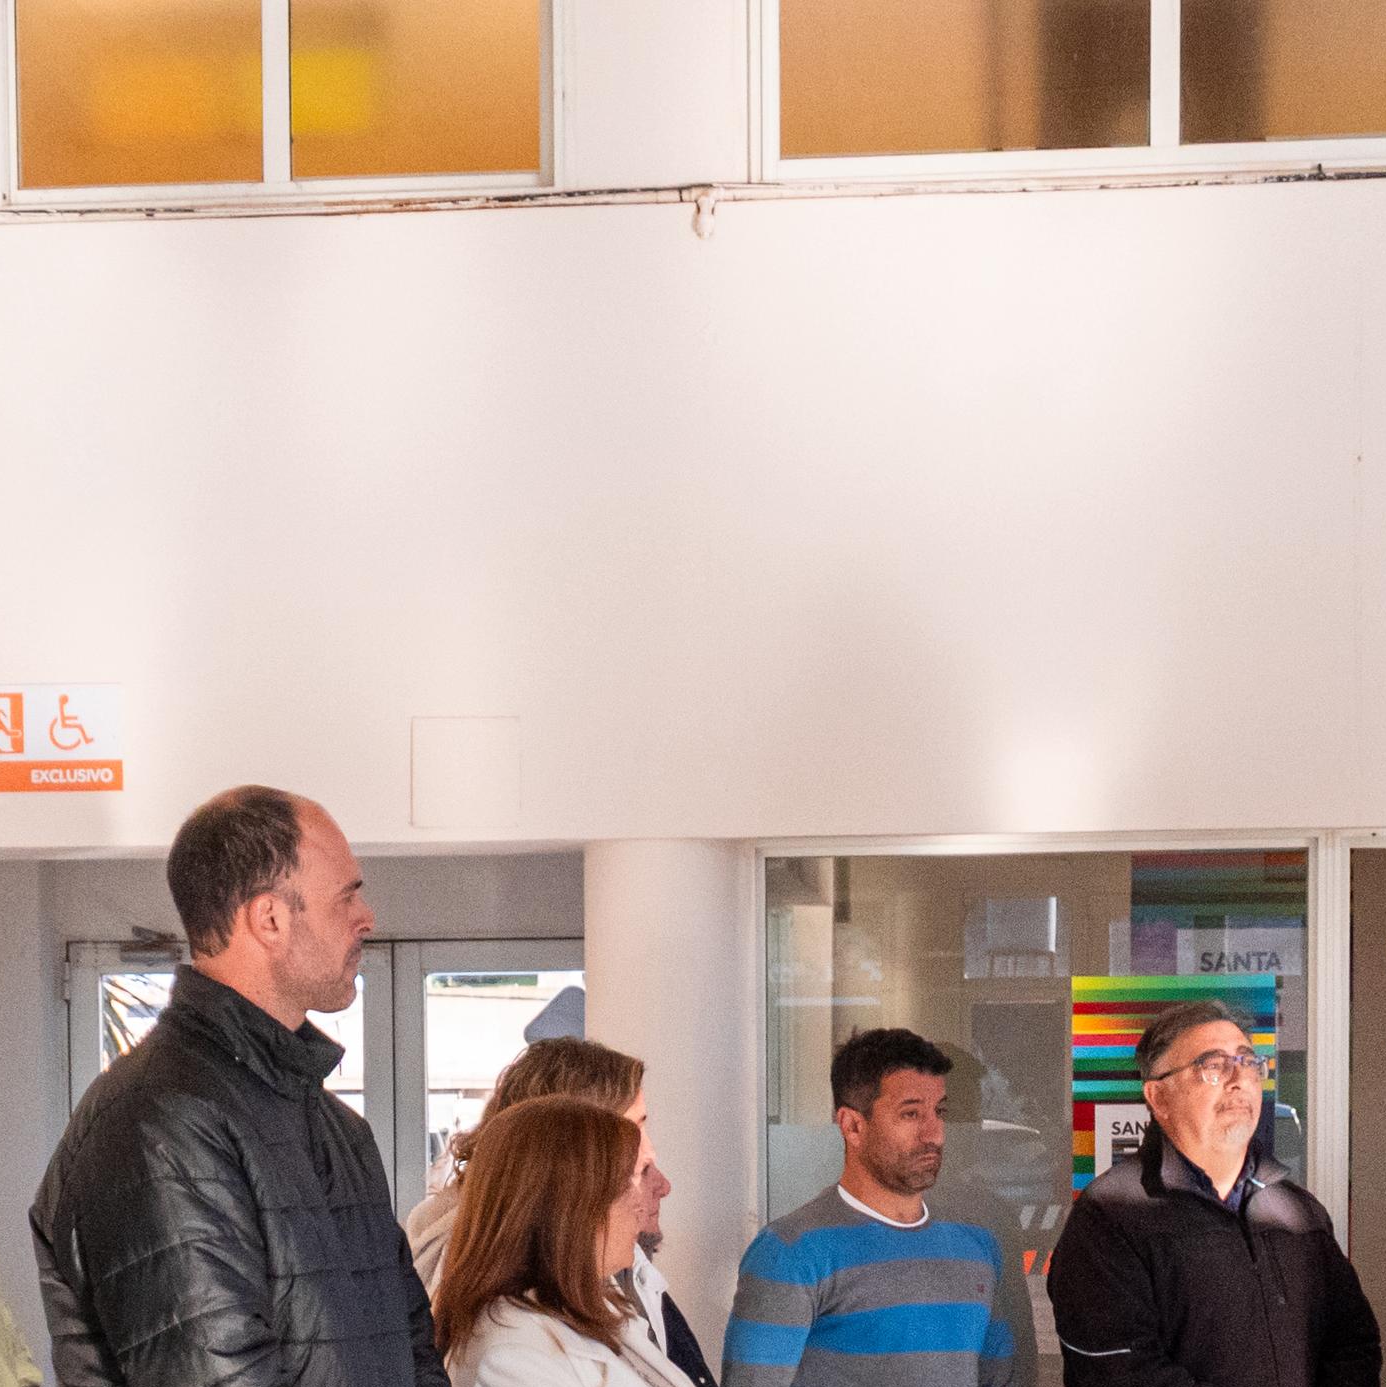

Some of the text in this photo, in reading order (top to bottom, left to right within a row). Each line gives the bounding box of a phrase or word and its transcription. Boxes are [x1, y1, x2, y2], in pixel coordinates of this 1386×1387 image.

[30, 767, 114, 784] EXCLUSIVO
[1199, 951, 1282, 973] SANTA
[1111, 1120, 1149, 1136] SAN
